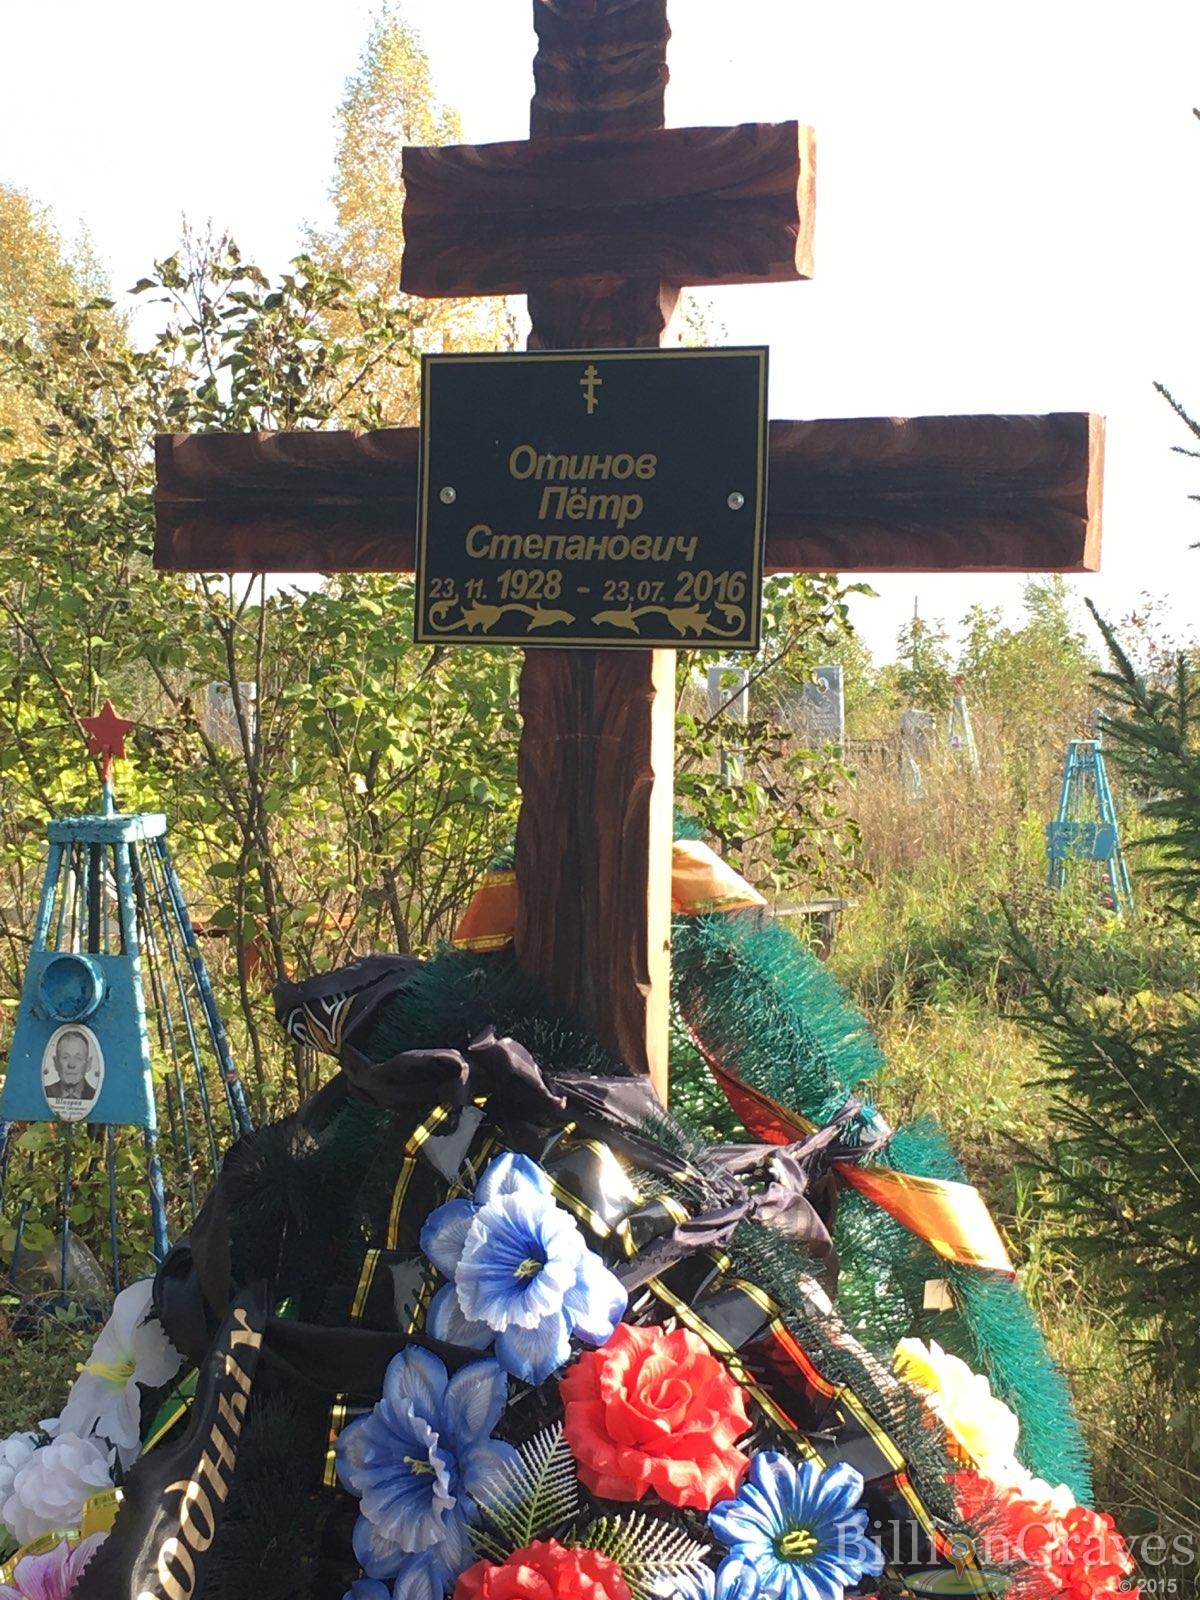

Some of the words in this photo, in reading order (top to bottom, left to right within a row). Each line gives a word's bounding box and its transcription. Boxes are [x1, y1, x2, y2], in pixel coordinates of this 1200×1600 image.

[509, 445, 657, 480] Отинов
[539, 486, 644, 529] Пётр
[465, 525, 698, 562] Степанович
[497, 569, 562, 600] 1928
[673, 570, 747, 602] 2016
[137, 1308, 262, 1600] одных
